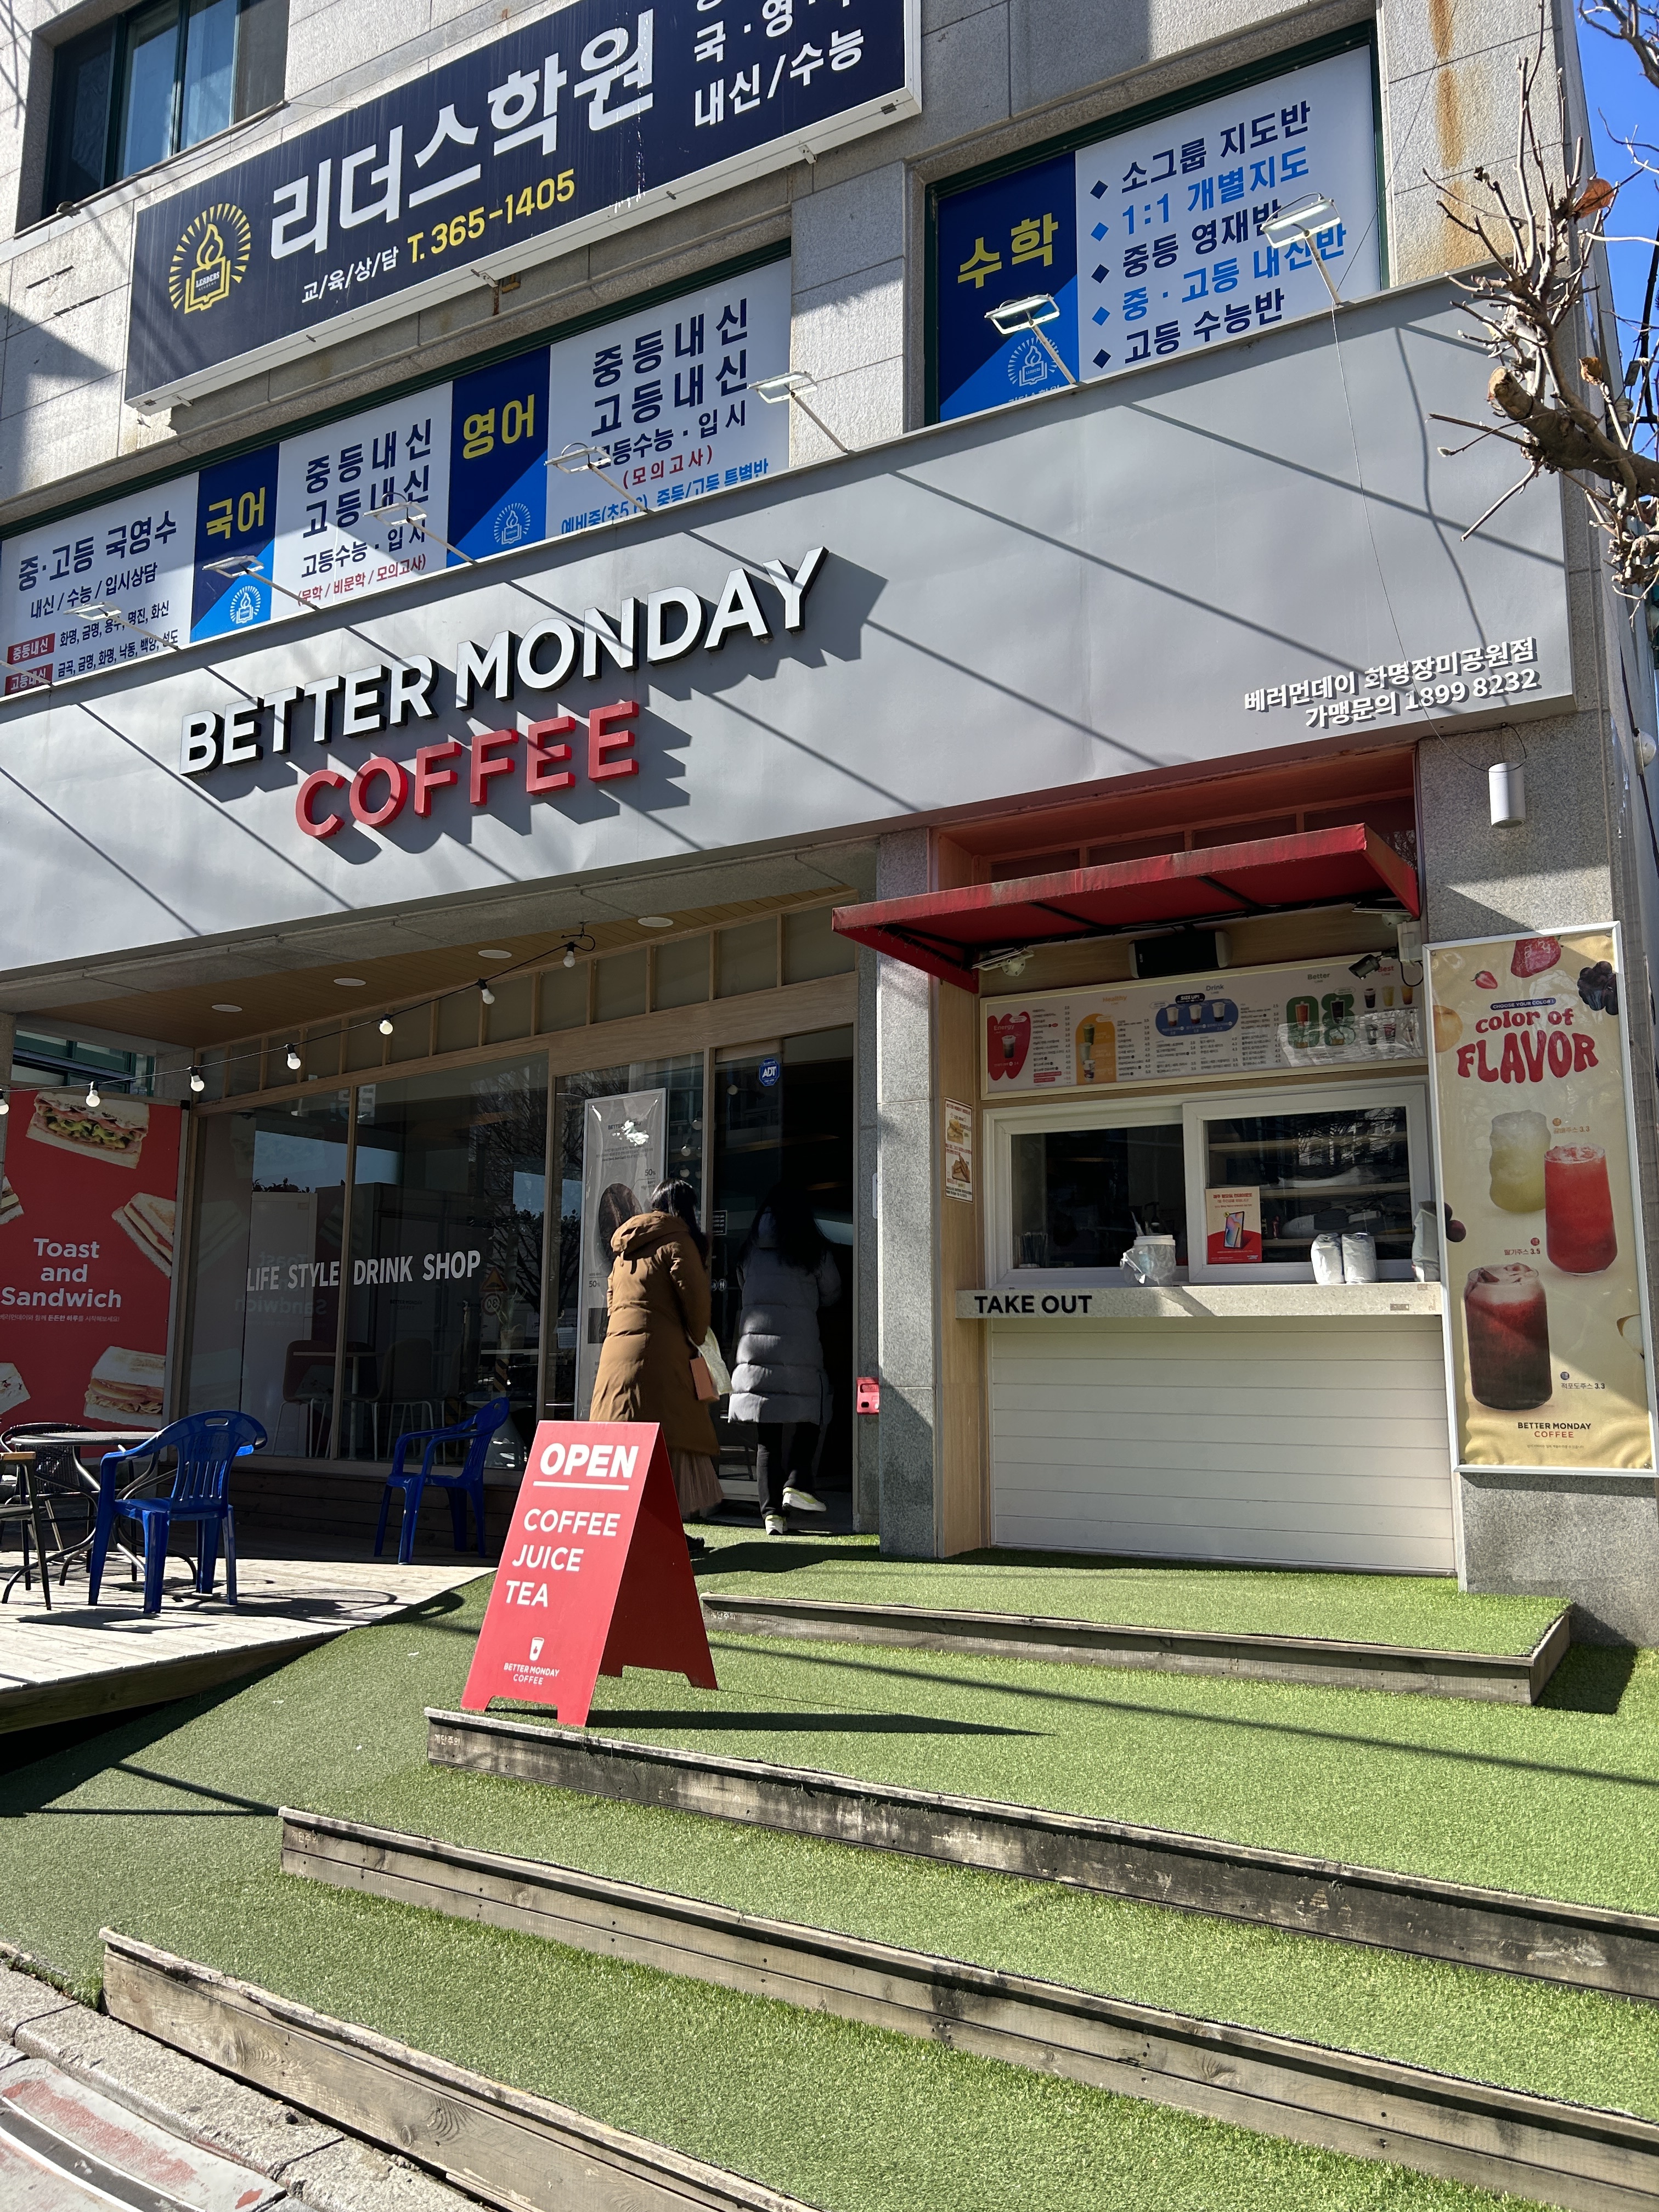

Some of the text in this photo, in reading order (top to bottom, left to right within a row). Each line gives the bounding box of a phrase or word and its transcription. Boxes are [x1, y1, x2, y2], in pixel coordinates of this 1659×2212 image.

[694, 26, 865, 127] 내신/수능
[271, 9, 654, 259] 리더스학원
[1121, 100, 1311, 194] 소그룹 지도반
[1122, 146, 1310, 236] 1:1 개별지도
[957, 212, 1059, 289] 수학
[1122, 233, 1179, 278] 중등
[592, 298, 748, 388] 중등내신
[1125, 287, 1285, 364] 고등 수능반
[591, 349, 748, 437] 고등내신
[462, 393, 534, 460] 영어
[305, 418, 432, 494] 중등내신
[623, 445, 713, 490] (모의고사)
[206, 486, 266, 540] 국어
[302, 464, 430, 539] 고등내신
[105, 510, 177, 559] 국영수
[105, 562, 158, 596] 입시상담
[13, 637, 49, 662] 중등내신
[59, 624, 80, 647] 화명,
[82, 621, 103, 641] 금명,
[151, 600, 170, 620] 화신
[179, 546, 830, 777] BETTER MONDAY
[1244, 636, 1538, 712] 베러먼데이 화명장미공원점
[1305, 668, 1539, 729] 가맹문의 1899 8232
[295, 699, 640, 839] COFFEE
[1475, 1008, 1574, 1033] color of
[761, 1066, 777, 1078] ADT
[1456, 1030, 1599, 1084] FLAVOR
[33, 1238, 100, 1259] Toast
[40, 1264, 88, 1283] and
[246, 1266, 280, 1291] LIFE
[287, 1261, 340, 1288] STYLE
[353, 1255, 413, 1285] DRINK
[422, 1250, 481, 1281] SHOP
[1, 1287, 122, 1308] Sandwich
[974, 1294, 1093, 1314] TAKE OUT
[540, 1443, 639, 1478] OPEN
[523, 1508, 621, 1537] COFFEE
[512, 1544, 584, 1572] JUICE
[505, 1581, 549, 1607] TEA
[503, 1662, 560, 1677] BETTER MONDAY
[513, 1674, 544, 1685] COFFEE
